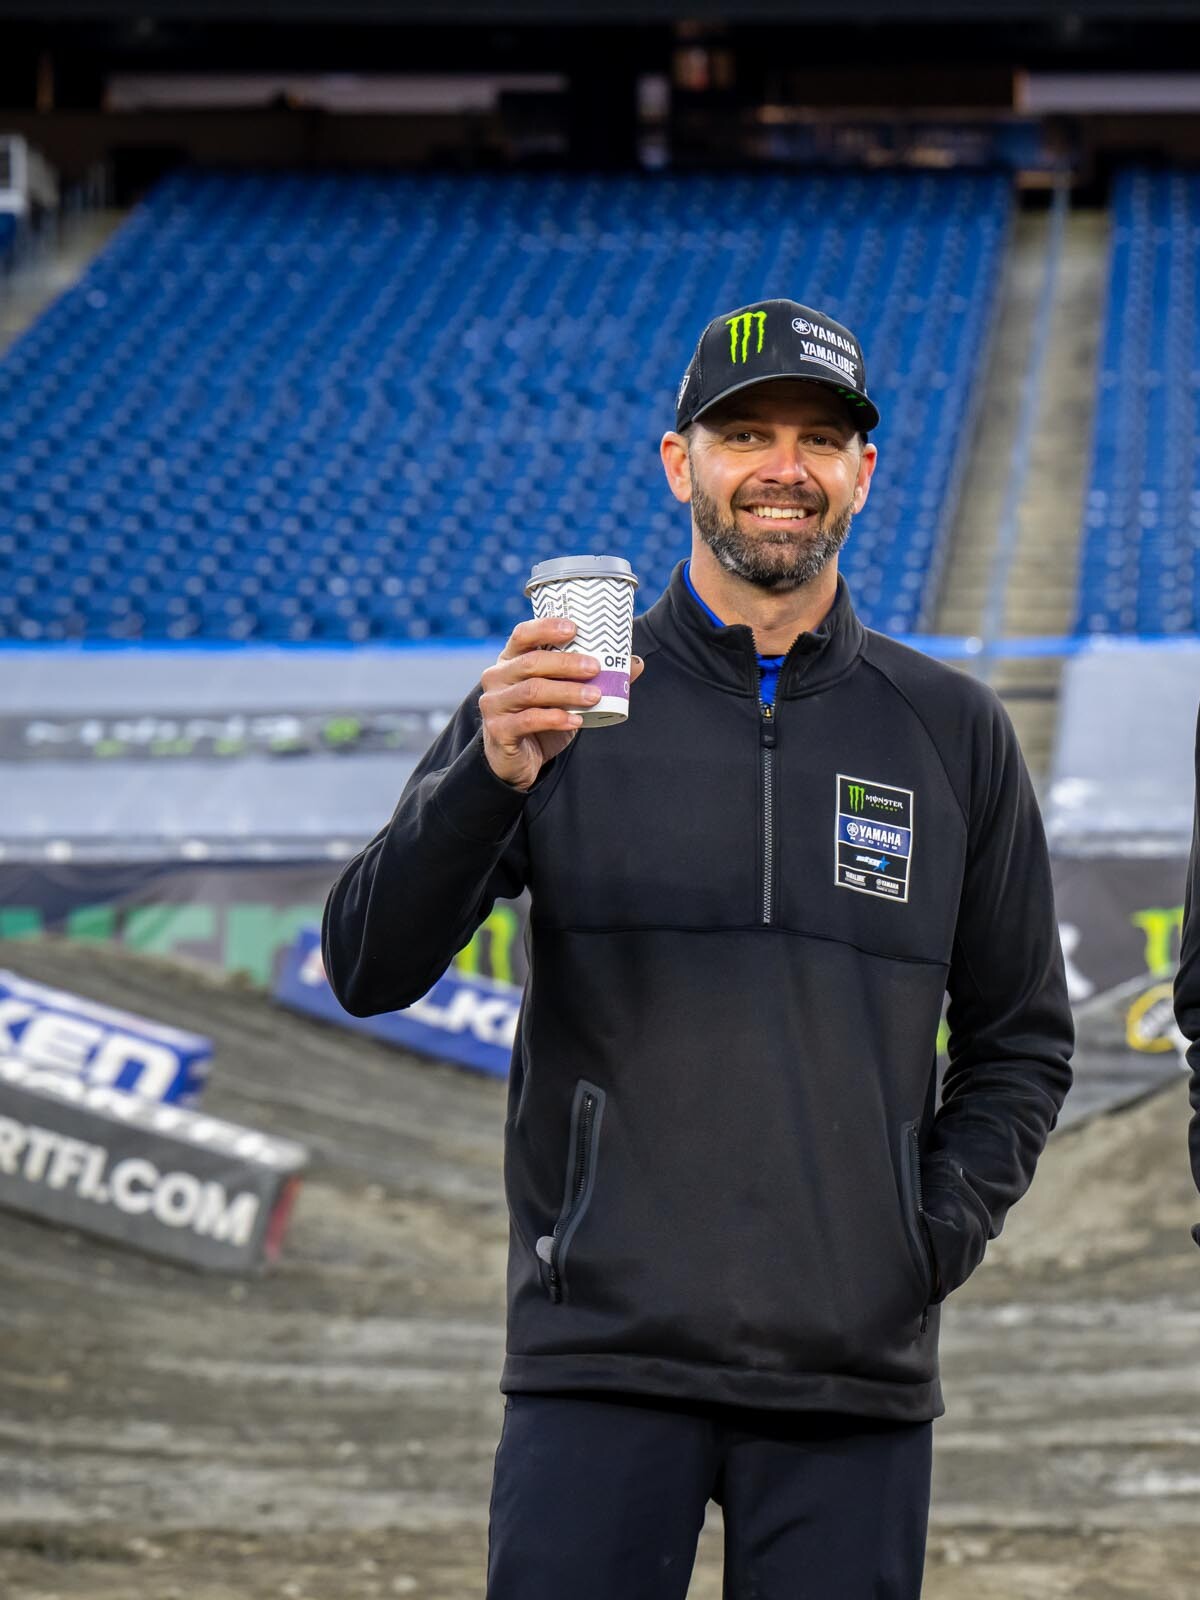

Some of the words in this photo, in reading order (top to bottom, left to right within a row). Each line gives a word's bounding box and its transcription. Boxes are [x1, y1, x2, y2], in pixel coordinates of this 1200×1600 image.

[810, 323, 858, 359] YAMAHA
[801, 340, 856, 377] YAMALUBE
[865, 794, 903, 809] MONSTER
[859, 825, 902, 846] YAMAHA
